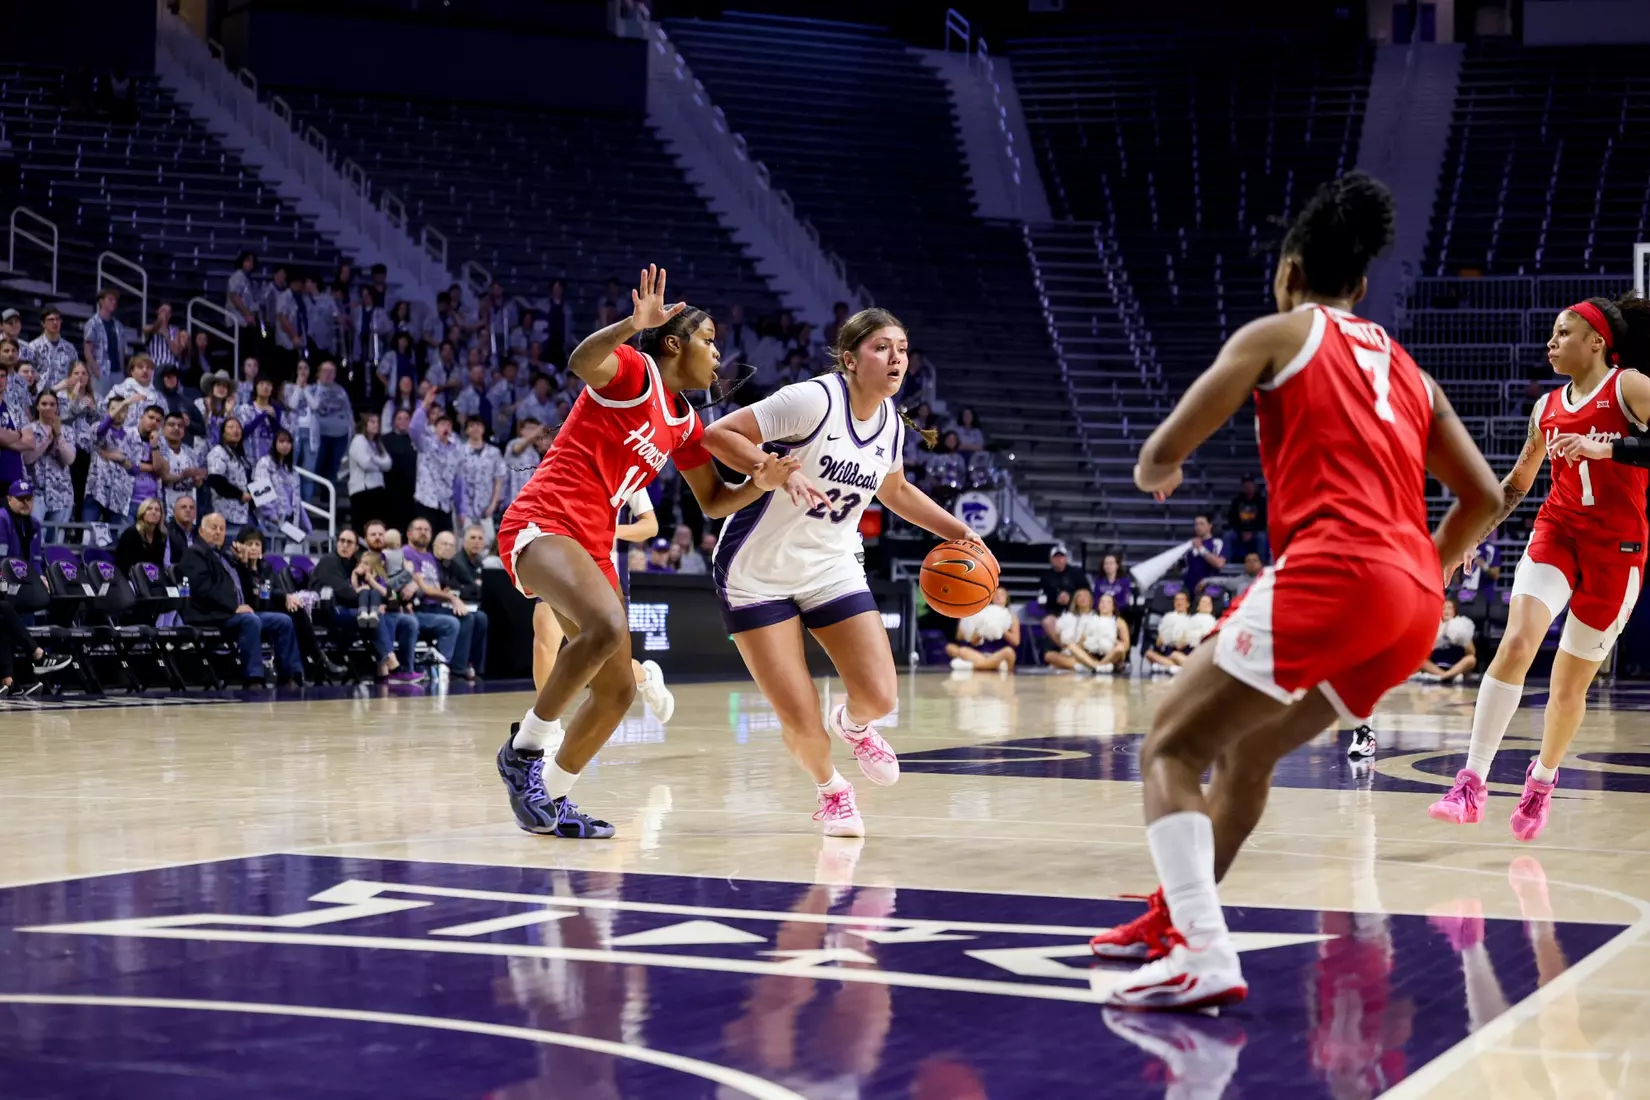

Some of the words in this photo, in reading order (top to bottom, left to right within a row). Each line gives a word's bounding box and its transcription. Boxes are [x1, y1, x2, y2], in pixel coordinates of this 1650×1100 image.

[1352, 344, 1396, 424] 7
[1578, 459, 1595, 506] 1
[805, 488, 862, 525] 23
